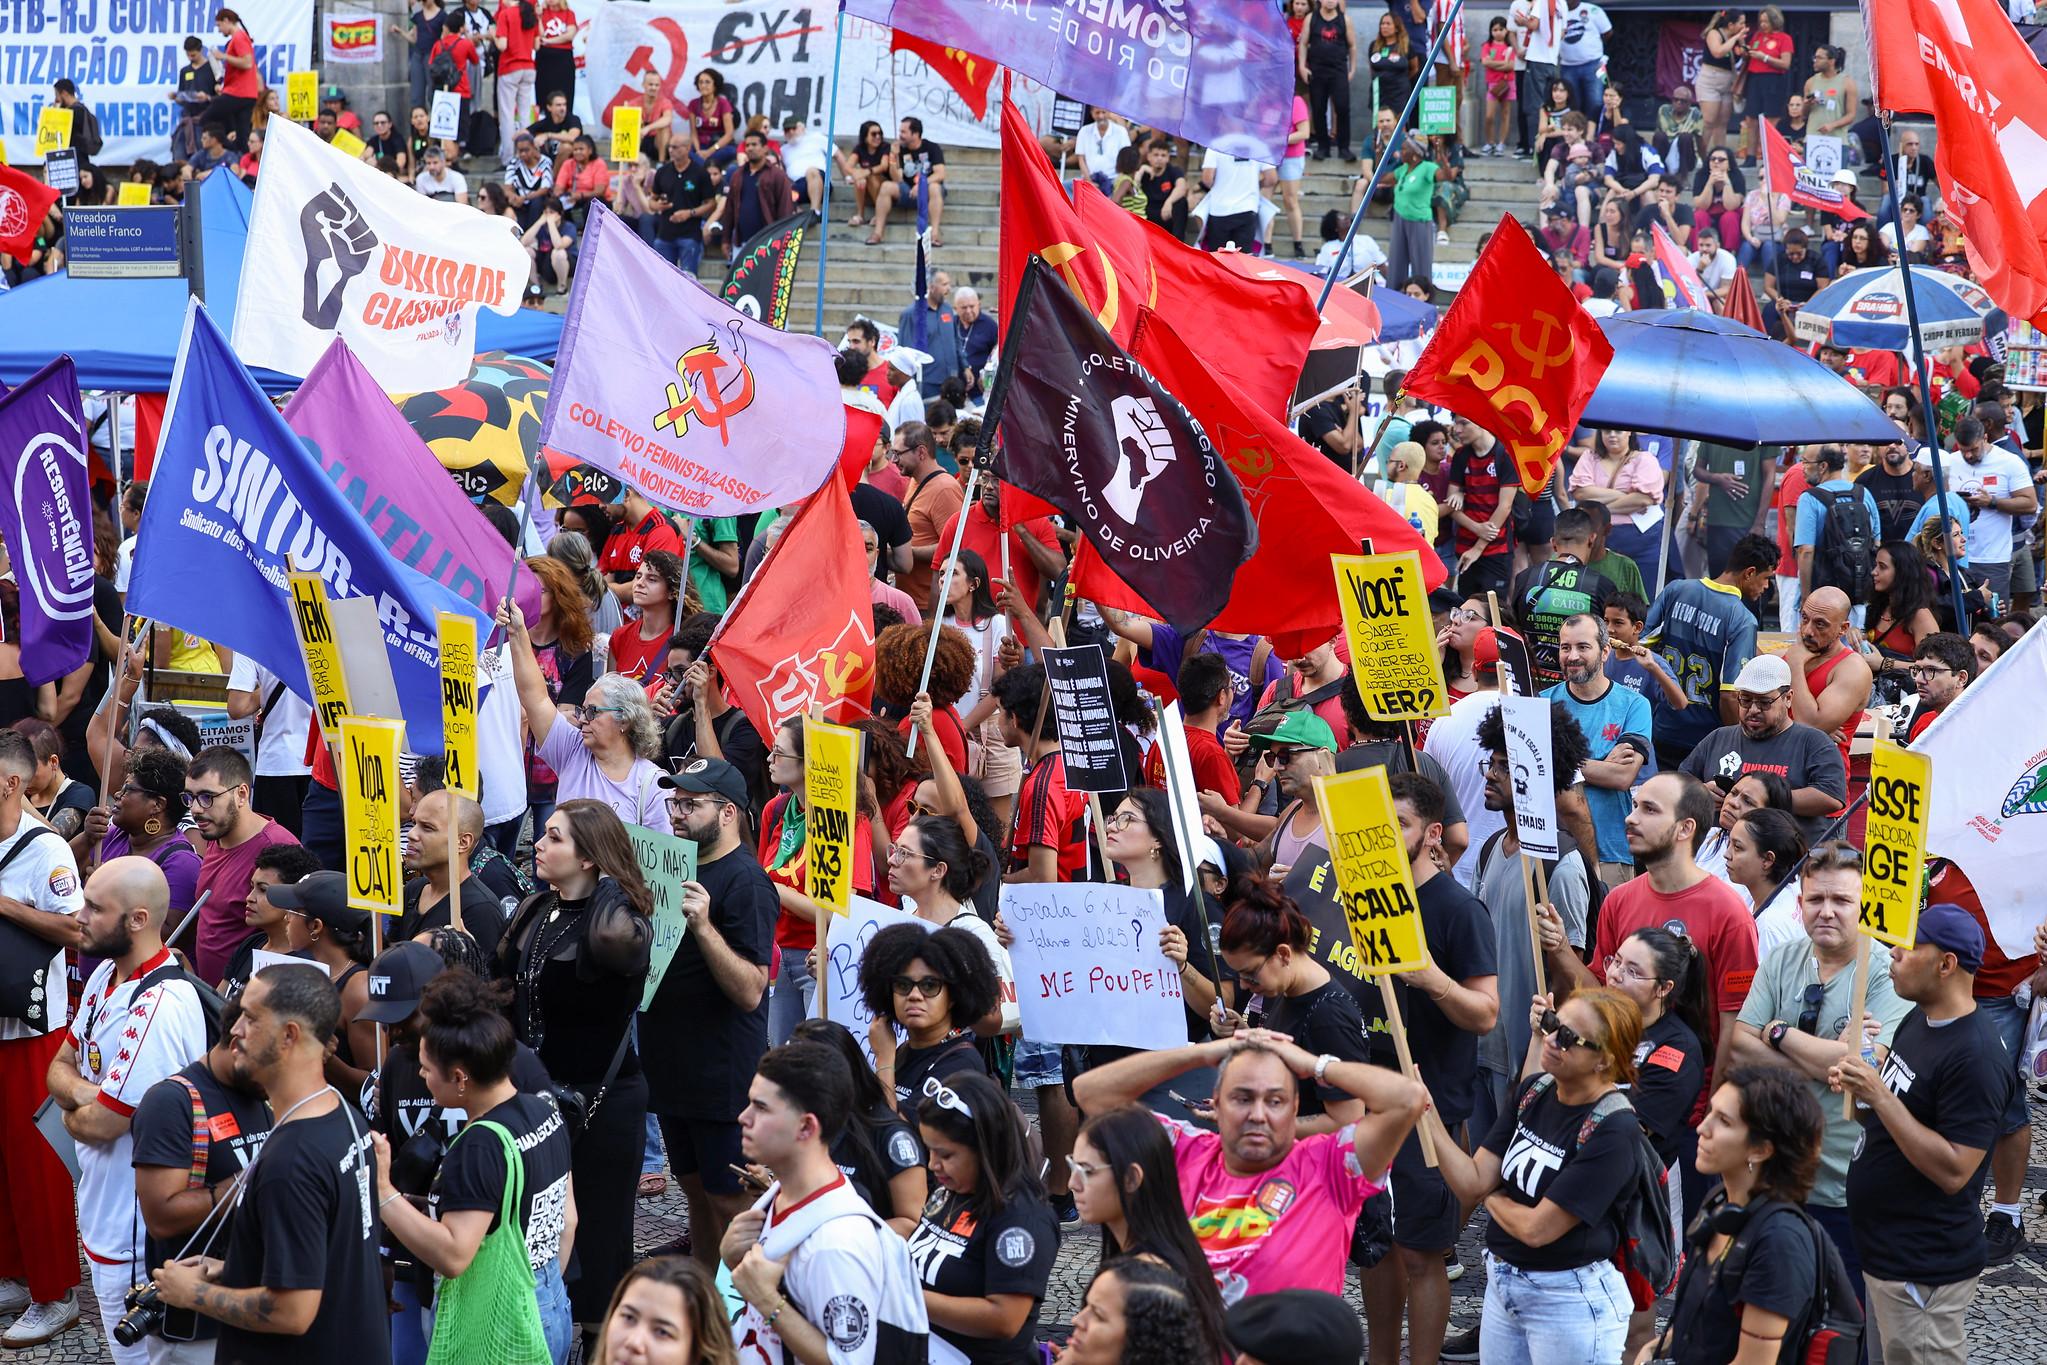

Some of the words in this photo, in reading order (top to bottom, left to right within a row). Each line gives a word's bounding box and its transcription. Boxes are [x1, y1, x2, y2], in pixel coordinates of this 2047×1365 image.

[333, 25, 375, 48] CTB
[138, 46, 180, 84] DA
[68, 212, 117, 223] Vereadora
[70, 225, 107, 237] Marielle
[109, 225, 142, 237] Franco
[380, 242, 506, 306] UNIDADE
[1855, 302, 1899, 313] BRAHMA
[1923, 329, 1944, 342] CHOPP
[1946, 329, 1954, 340] DE
[569, 402, 645, 454] COLETIVO
[1082, 353, 1172, 396] COLETIVO
[1177, 401, 1216, 489] NEGRO
[583, 472, 609, 493] elo
[1063, 394, 1099, 521] MINERVINO
[1098, 523, 1125, 552] DE
[1129, 516, 1213, 562] OLIVEIRA
[39, 447, 95, 590] RESISTÊNCIA
[48, 521, 59, 552] PSOL
[179, 507, 224, 539] Sindicato
[223, 528, 245, 552] dos
[386, 632, 402, 648] da
[403, 640, 439, 669] UFRRJ
[1346, 566, 1410, 621] VOCÊ
[1551, 598, 1586, 611] CARD
[1671, 600, 1695, 623] NEW
[1370, 639, 1396, 653] QUE
[1368, 668, 1392, 680] SEU
[1392, 664, 1431, 678] FILHO
[1376, 655, 1399, 668] VER
[1400, 653, 1425, 666] SEU
[1070, 677, 1076, 690] É
[1075, 676, 1104, 690] INIMIGA
[1623, 675, 1643, 687] Good
[1077, 708, 1082, 722] É
[1081, 707, 1110, 721] INIMIGA
[1373, 689, 1436, 717] LER?
[1083, 739, 1088, 753] É
[1088, 738, 1115, 752] INIMIGA
[1507, 723, 1518, 735] FIM
[1517, 728, 1526, 741] DA
[1525, 737, 1541, 764] ESCALA
[352, 735, 387, 804] VIDA
[663, 849, 690, 882] MAIS
[1339, 858, 1399, 890] CONTRA
[644, 878, 669, 910] OM
[1006, 893, 1078, 923] Escala
[1881, 887, 1903, 904] DA
[1354, 927, 1401, 967] 6X1
[1039, 970, 1075, 999] ME
[398, 1099, 412, 1108] VIDA
[412, 1097, 430, 1107] ALÉM
[1189, 1206, 1269, 1240] CTB
